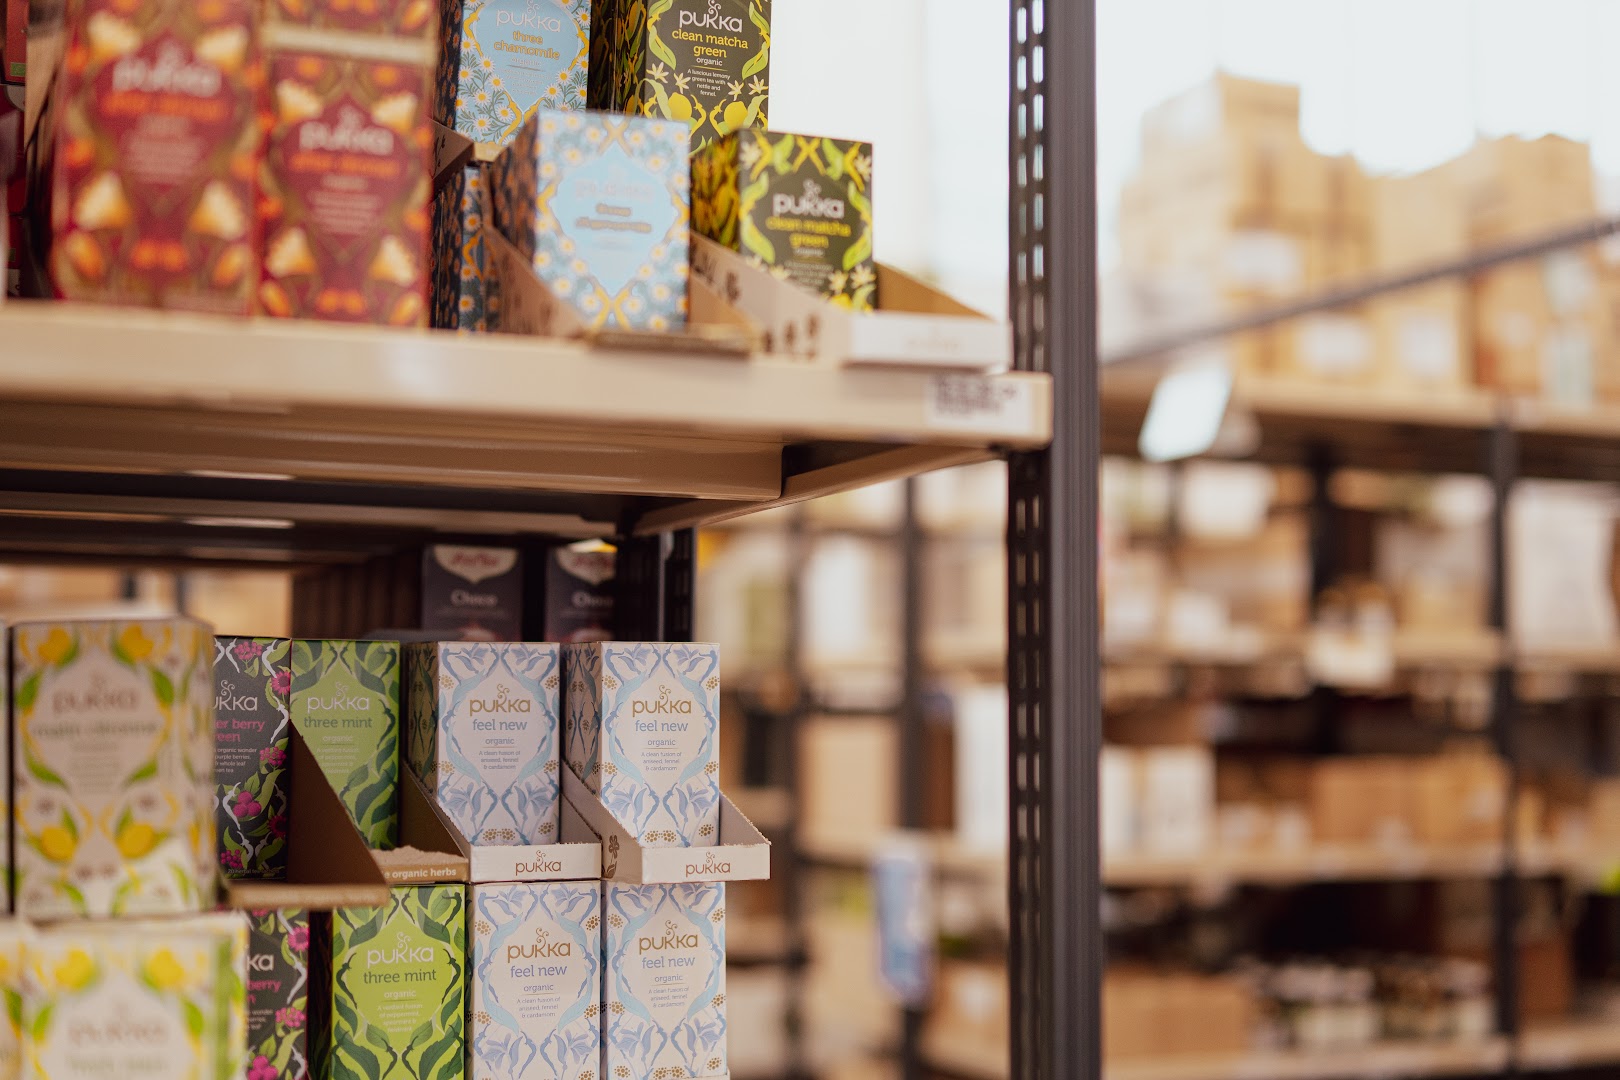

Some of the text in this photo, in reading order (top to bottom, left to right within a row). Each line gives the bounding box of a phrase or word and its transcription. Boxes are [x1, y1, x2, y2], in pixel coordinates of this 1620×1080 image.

[497, 0, 560, 32] pukka
[680, 0, 742, 32] pukka
[513, 30, 543, 44] three
[672, 29, 748, 49] clean matcha
[494, 40, 560, 60] chamomile
[694, 45, 727, 58] green
[696, 57, 722, 66] organic
[712, 72, 731, 80] lemony
[772, 179, 845, 219] pukka
[802, 220, 852, 237] matcha
[790, 233, 829, 249] green
[214, 680, 258, 711] kka
[307, 682, 369, 714] pukka
[470, 684, 531, 717] pukka
[632, 685, 692, 718] pukka
[232, 720, 265, 732] berry
[304, 716, 373, 728] three mint
[473, 719, 528, 731] feel new
[635, 719, 688, 732] feel new
[485, 737, 514, 746] organic
[648, 739, 676, 748] organic
[515, 850, 561, 876] pukka
[686, 851, 730, 877] pukka
[392, 869, 428, 880] organic
[430, 868, 456, 876] herbs
[508, 927, 570, 963] pukka
[639, 920, 698, 955] pukka
[367, 932, 434, 969] pukka
[642, 956, 695, 969] feel new
[363, 969, 436, 984] three mint
[511, 965, 567, 978] feel new
[654, 974, 683, 983] organic
[384, 990, 416, 999] organic
[524, 984, 554, 993] organic
